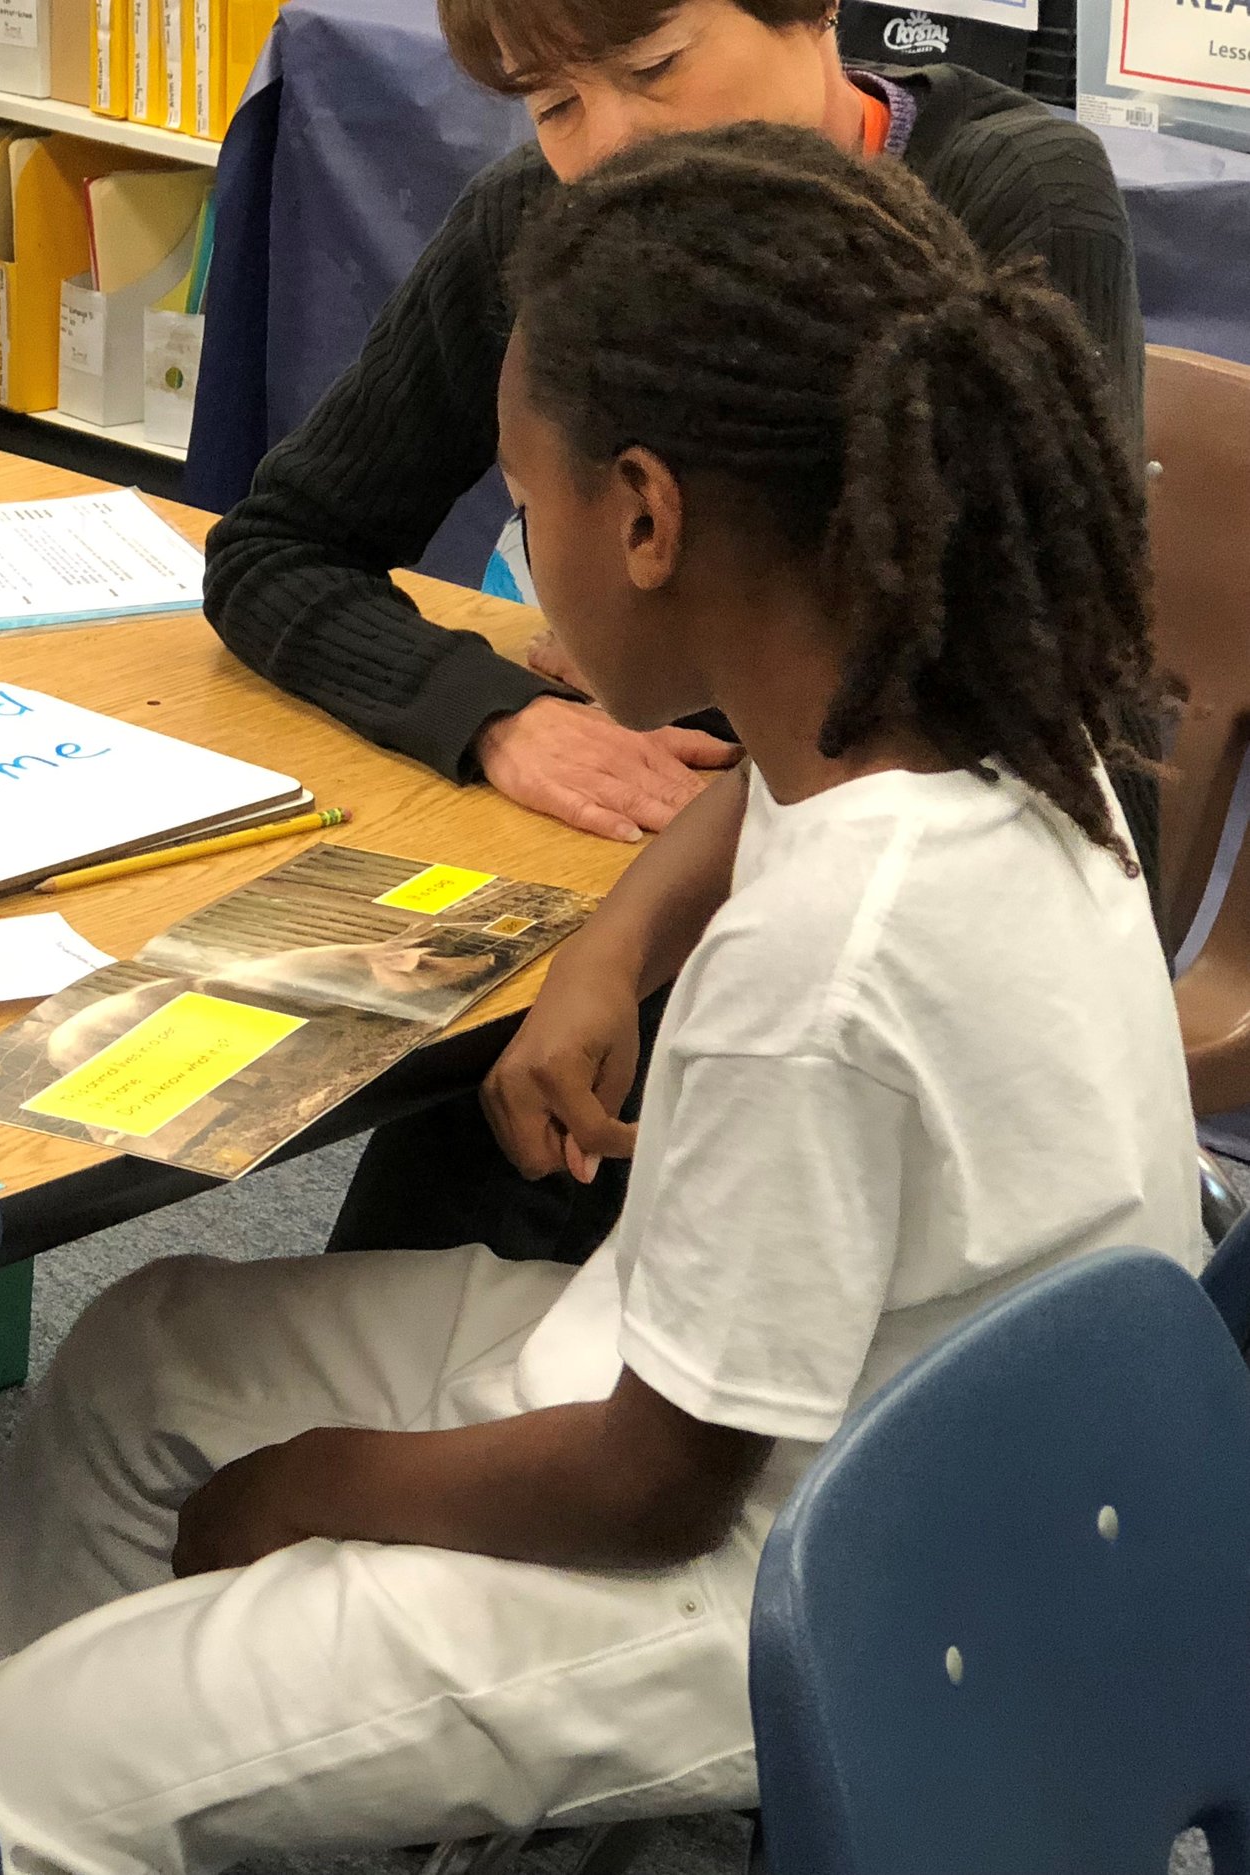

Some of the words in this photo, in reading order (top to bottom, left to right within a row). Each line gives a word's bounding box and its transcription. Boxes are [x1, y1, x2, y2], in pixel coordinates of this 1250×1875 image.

[1209, 39, 1250, 61] Less
[156, 1070, 188, 1091] know
[181, 1054, 211, 1073] what
